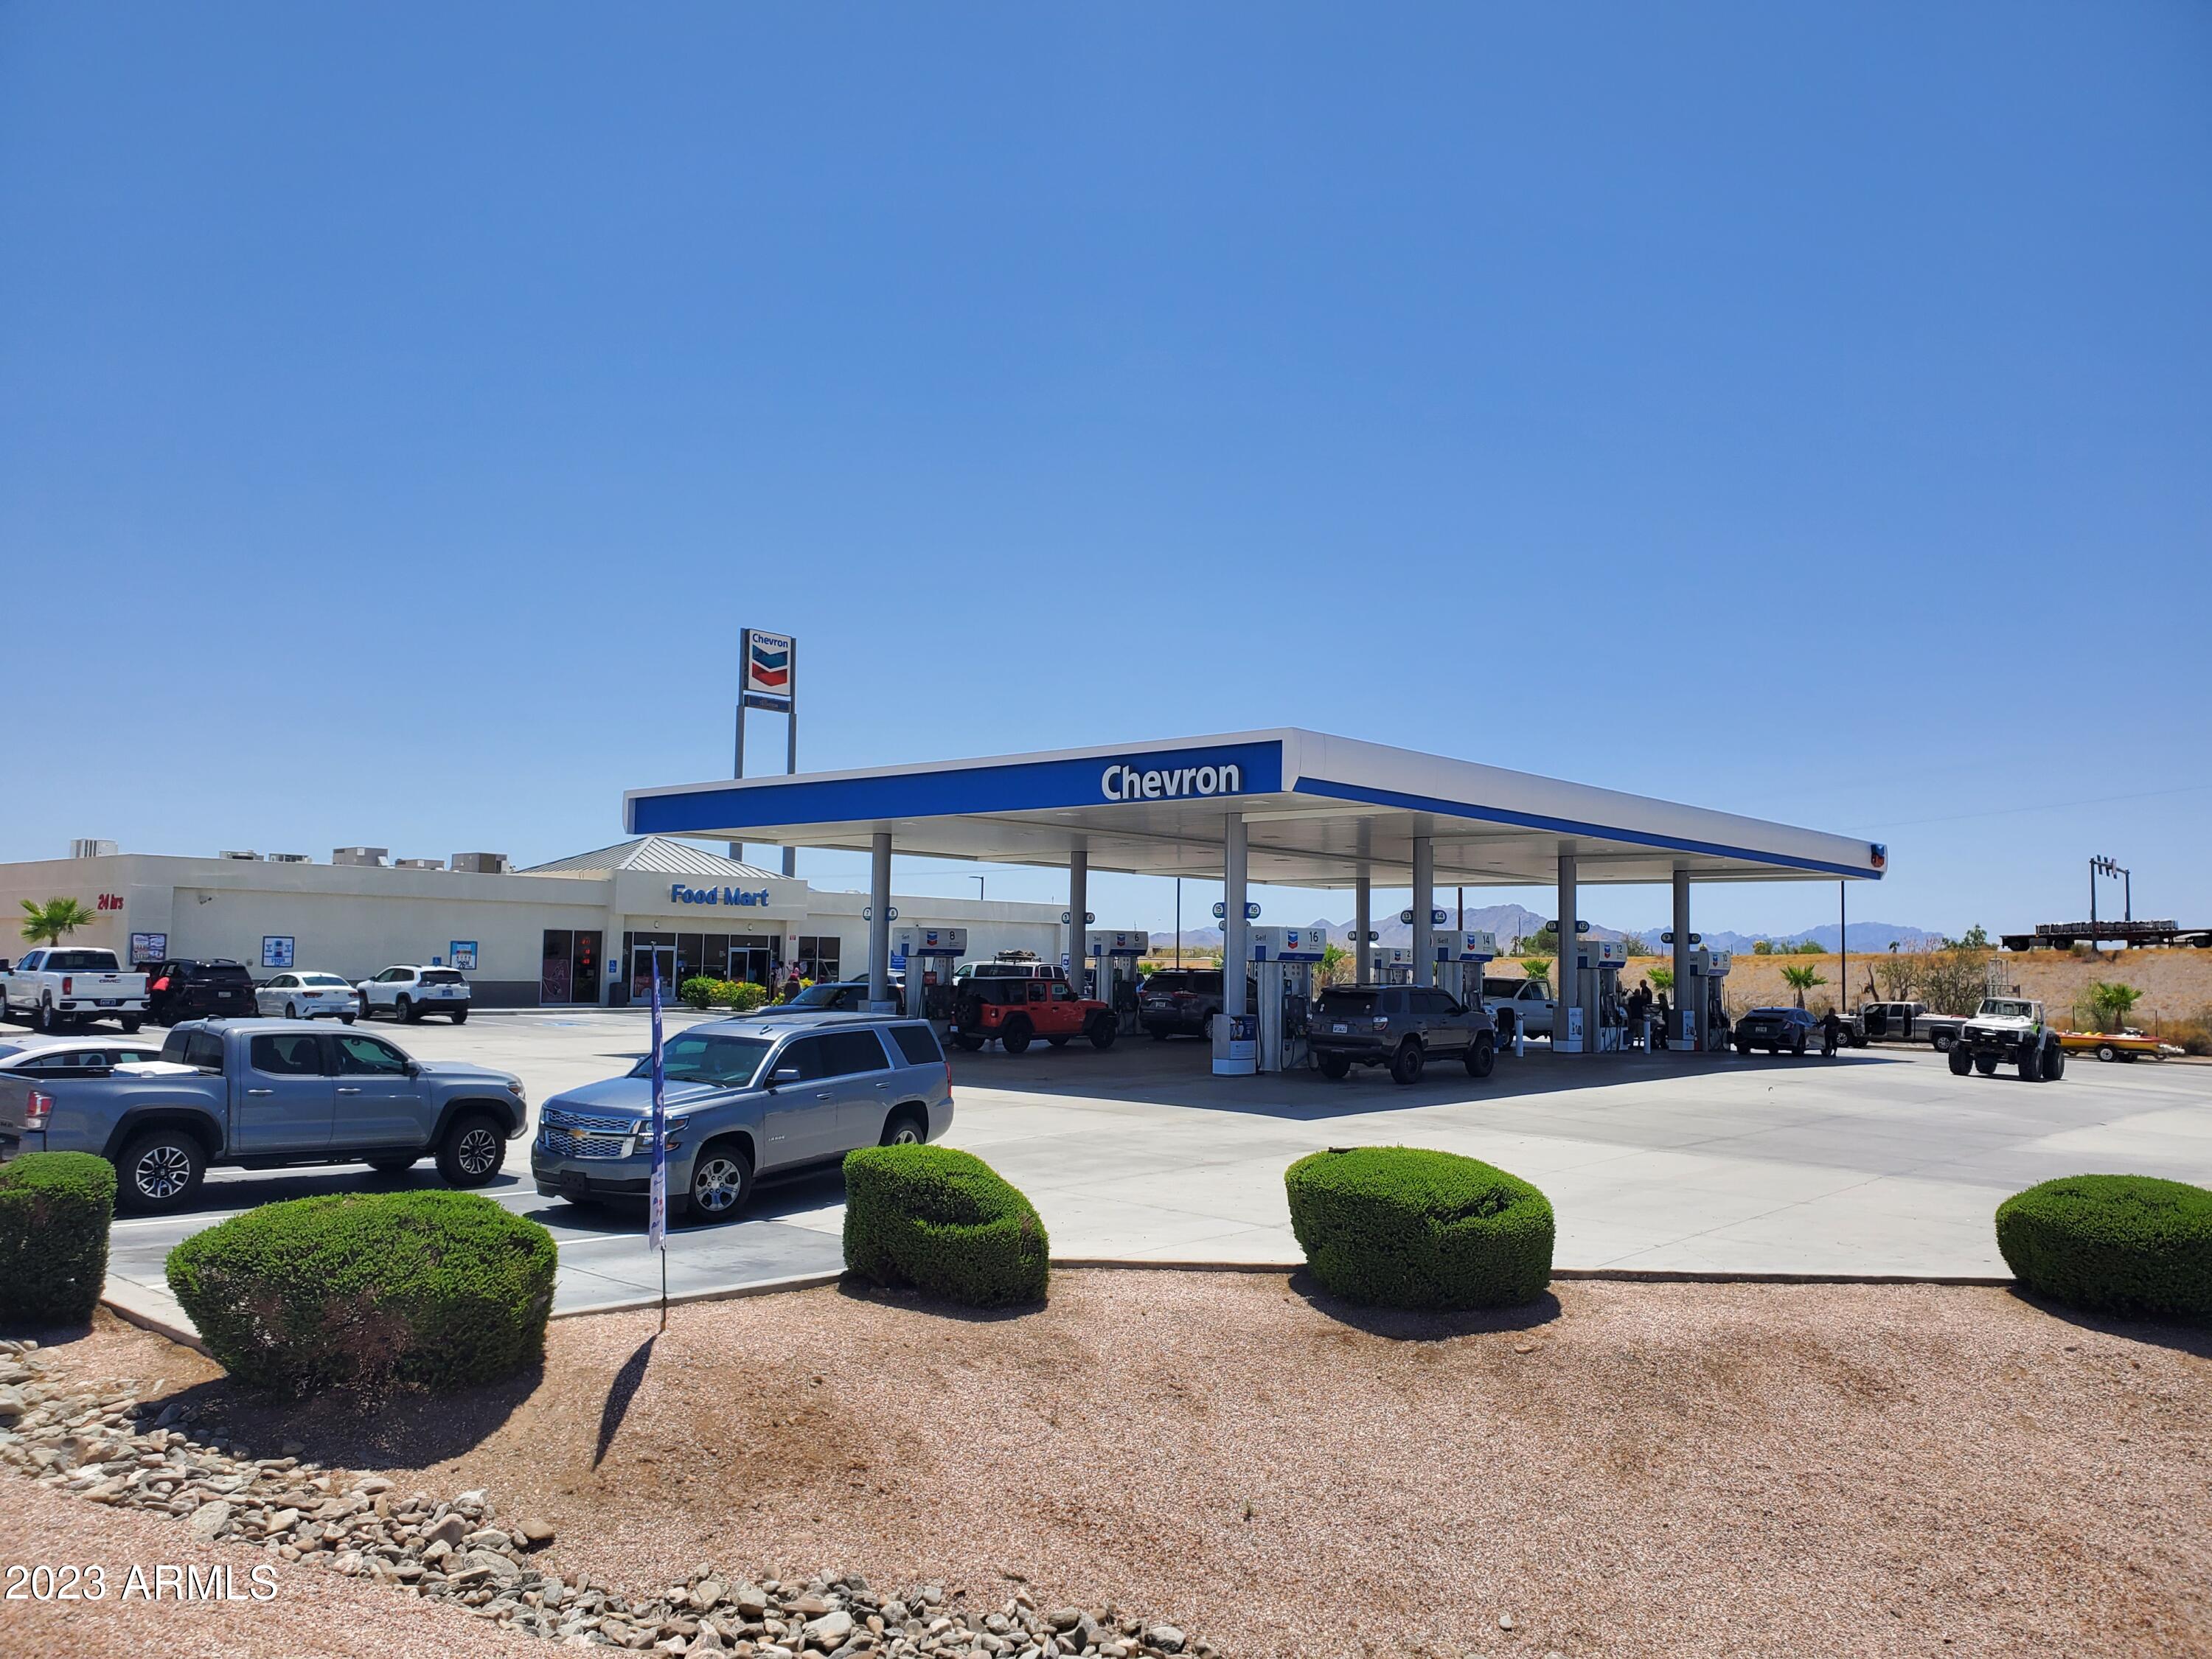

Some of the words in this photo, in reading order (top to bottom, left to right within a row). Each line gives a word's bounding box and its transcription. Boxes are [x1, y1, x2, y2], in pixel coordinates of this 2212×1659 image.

[752, 633, 788, 648] Chevron
[1102, 764, 1239, 801] Chevron
[671, 884, 718, 904] Food
[723, 887, 769, 906] Mart
[97, 893, 110, 910] 24
[111, 894, 124, 910] hrs
[949, 931, 956, 941] 8
[1134, 933, 1140, 942] 6
[1255, 933, 1267, 942] Self
[1309, 931, 1319, 942] 16
[1483, 935, 1490, 945] 14
[1616, 945, 1623, 953] 12
